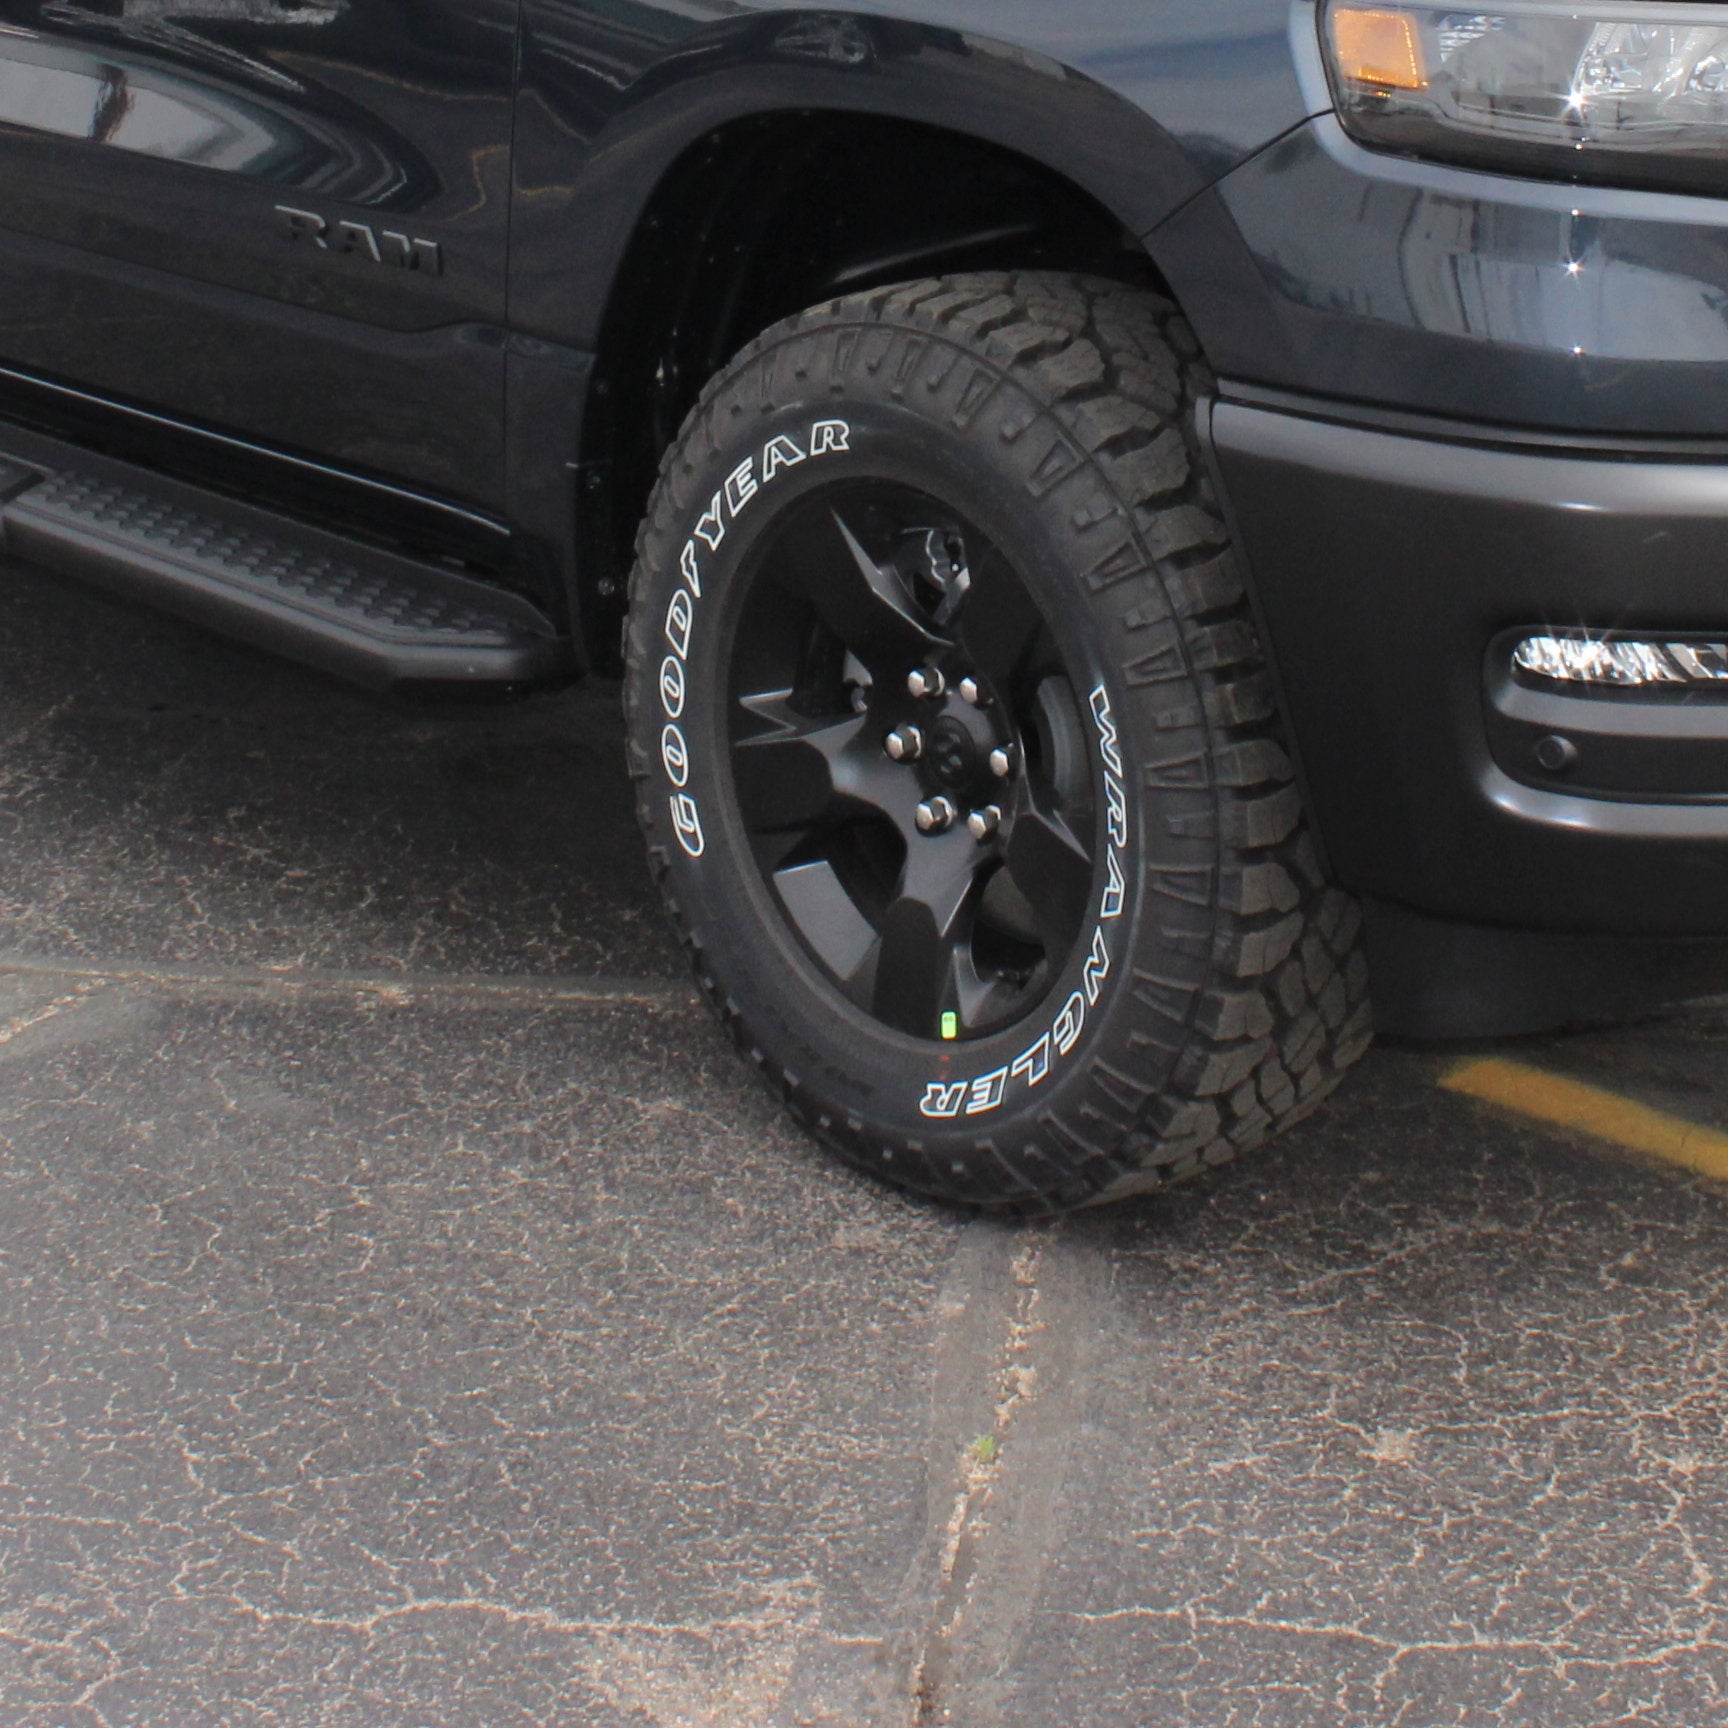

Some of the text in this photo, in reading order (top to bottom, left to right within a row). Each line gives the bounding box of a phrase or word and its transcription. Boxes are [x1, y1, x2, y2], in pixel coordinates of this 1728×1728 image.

[274, 203, 443, 277] RAM
[660, 419, 850, 858] GOODYEAR
[920, 684, 1127, 1118] WRANGLER
